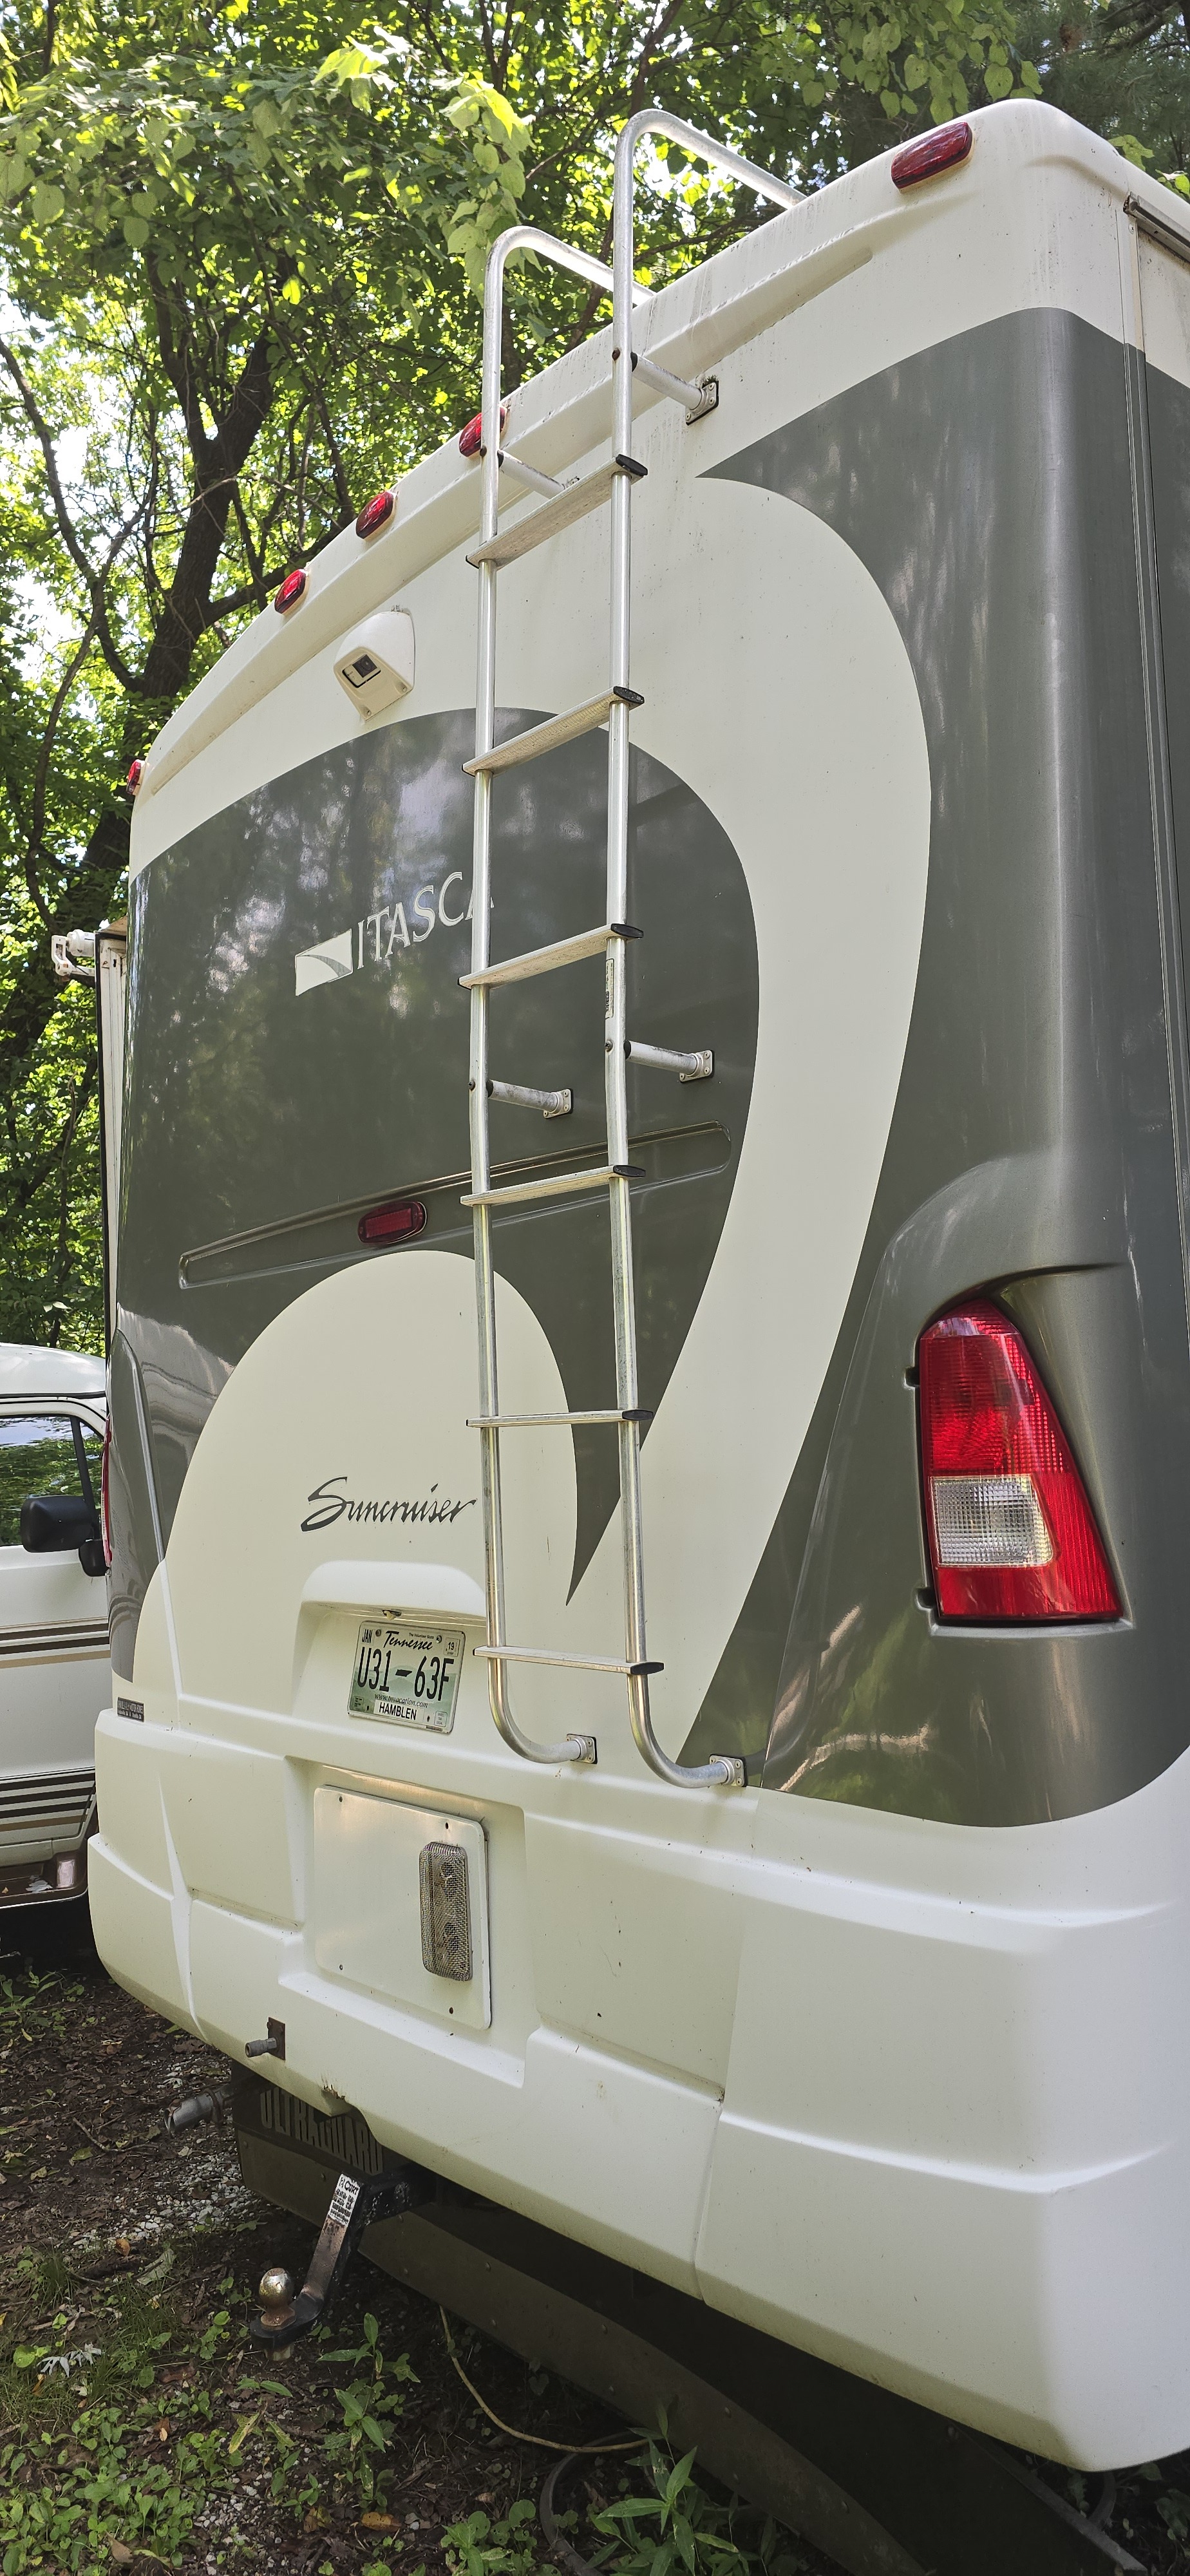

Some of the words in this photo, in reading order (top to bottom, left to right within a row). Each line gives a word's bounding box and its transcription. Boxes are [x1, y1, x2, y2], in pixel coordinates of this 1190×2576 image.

[300, 1476, 477, 1532] Suncruiser
[361, 1629, 373, 1643] JAN
[383, 1630, 433, 1651] Tennessee
[448, 1642, 455, 1651] 19
[374, 1693, 429, 1709] www.tnvacation.com
[379, 1701, 417, 1721] HAMBLEN
